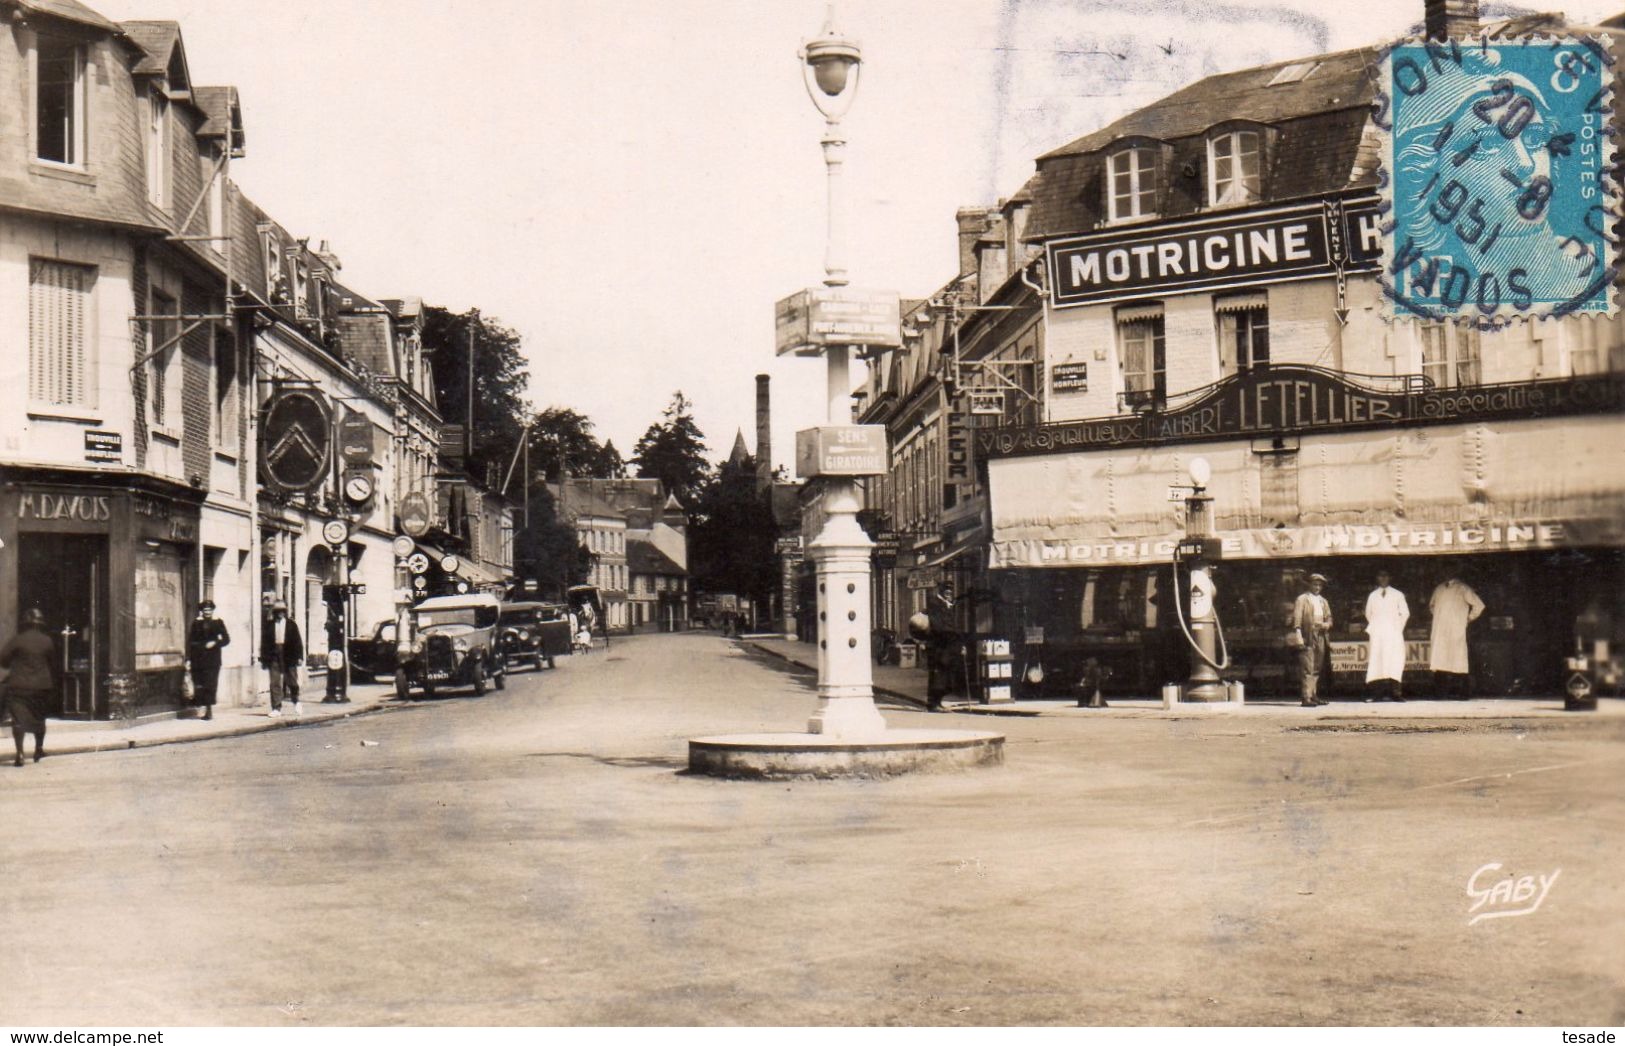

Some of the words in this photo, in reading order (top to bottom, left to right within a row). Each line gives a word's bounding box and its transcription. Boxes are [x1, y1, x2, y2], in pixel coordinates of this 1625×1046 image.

[1581, 113, 1596, 200] POSTES
[1358, 213, 1382, 252] H
[1419, 171, 1502, 256] 1951
[1069, 223, 1312, 288] MOTRICINE
[1329, 217, 1342, 261] VENTE
[1337, 265, 1346, 311] ICI
[837, 430, 869, 443] SENS
[1159, 398, 1226, 438] ALBERT
[825, 455, 881, 470] GIRATOIRE
[1040, 537, 1242, 561] MOTRICE
[1324, 522, 1567, 550] MOTRICINE
